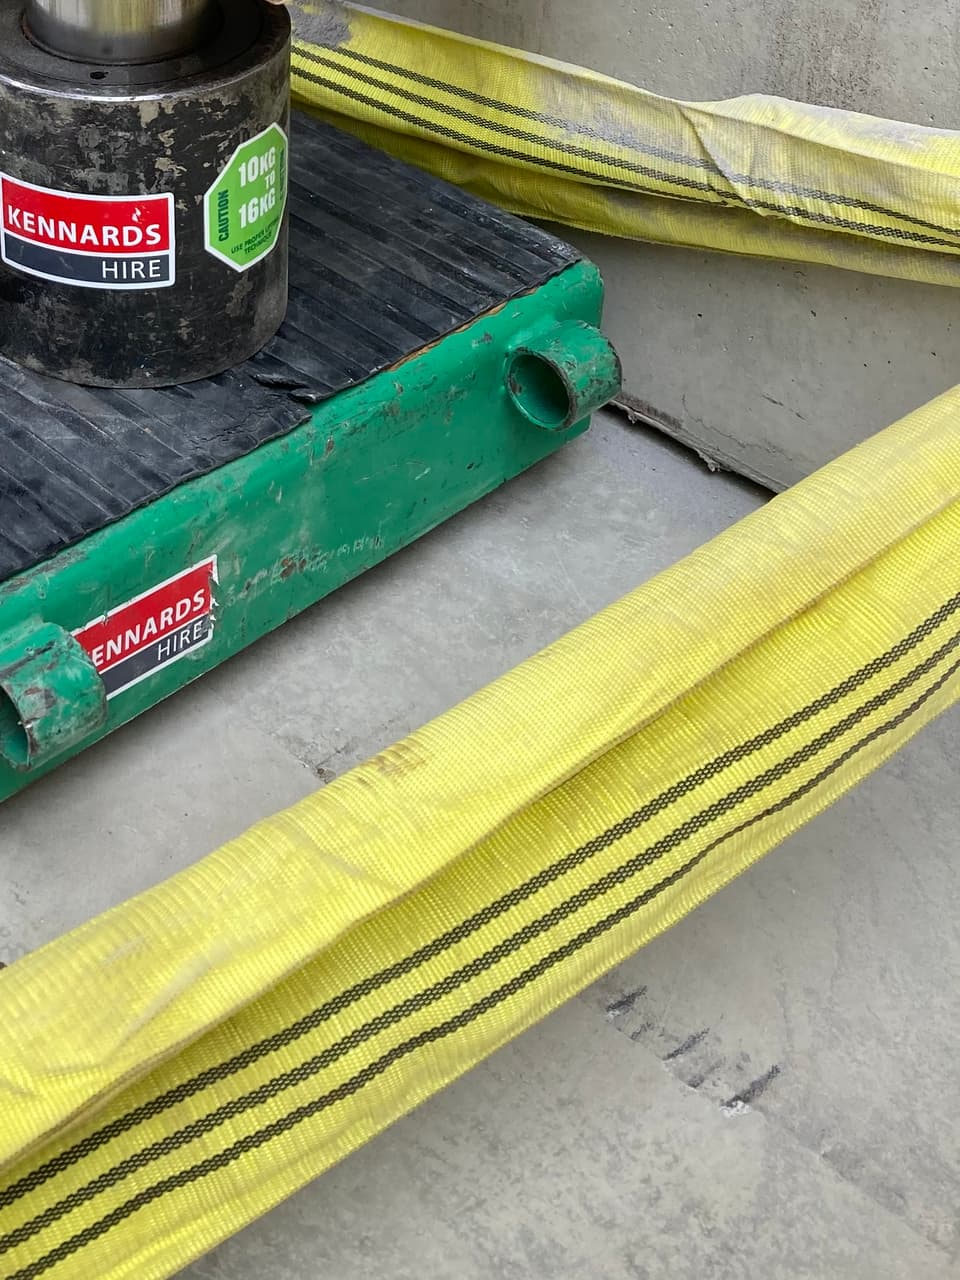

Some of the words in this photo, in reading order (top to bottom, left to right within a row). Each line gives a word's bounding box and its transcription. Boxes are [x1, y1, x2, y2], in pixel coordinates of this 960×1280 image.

[239, 146, 276, 188] 10KG
[265, 171, 275, 190] TO
[7, 204, 161, 247] KENNARDS
[218, 188, 229, 242] CAUTION
[239, 187, 276, 229] 16KG
[102, 259, 161, 279] HIRE
[91, 588, 206, 667] ENNARDS
[157, 620, 204, 661] HIRE
